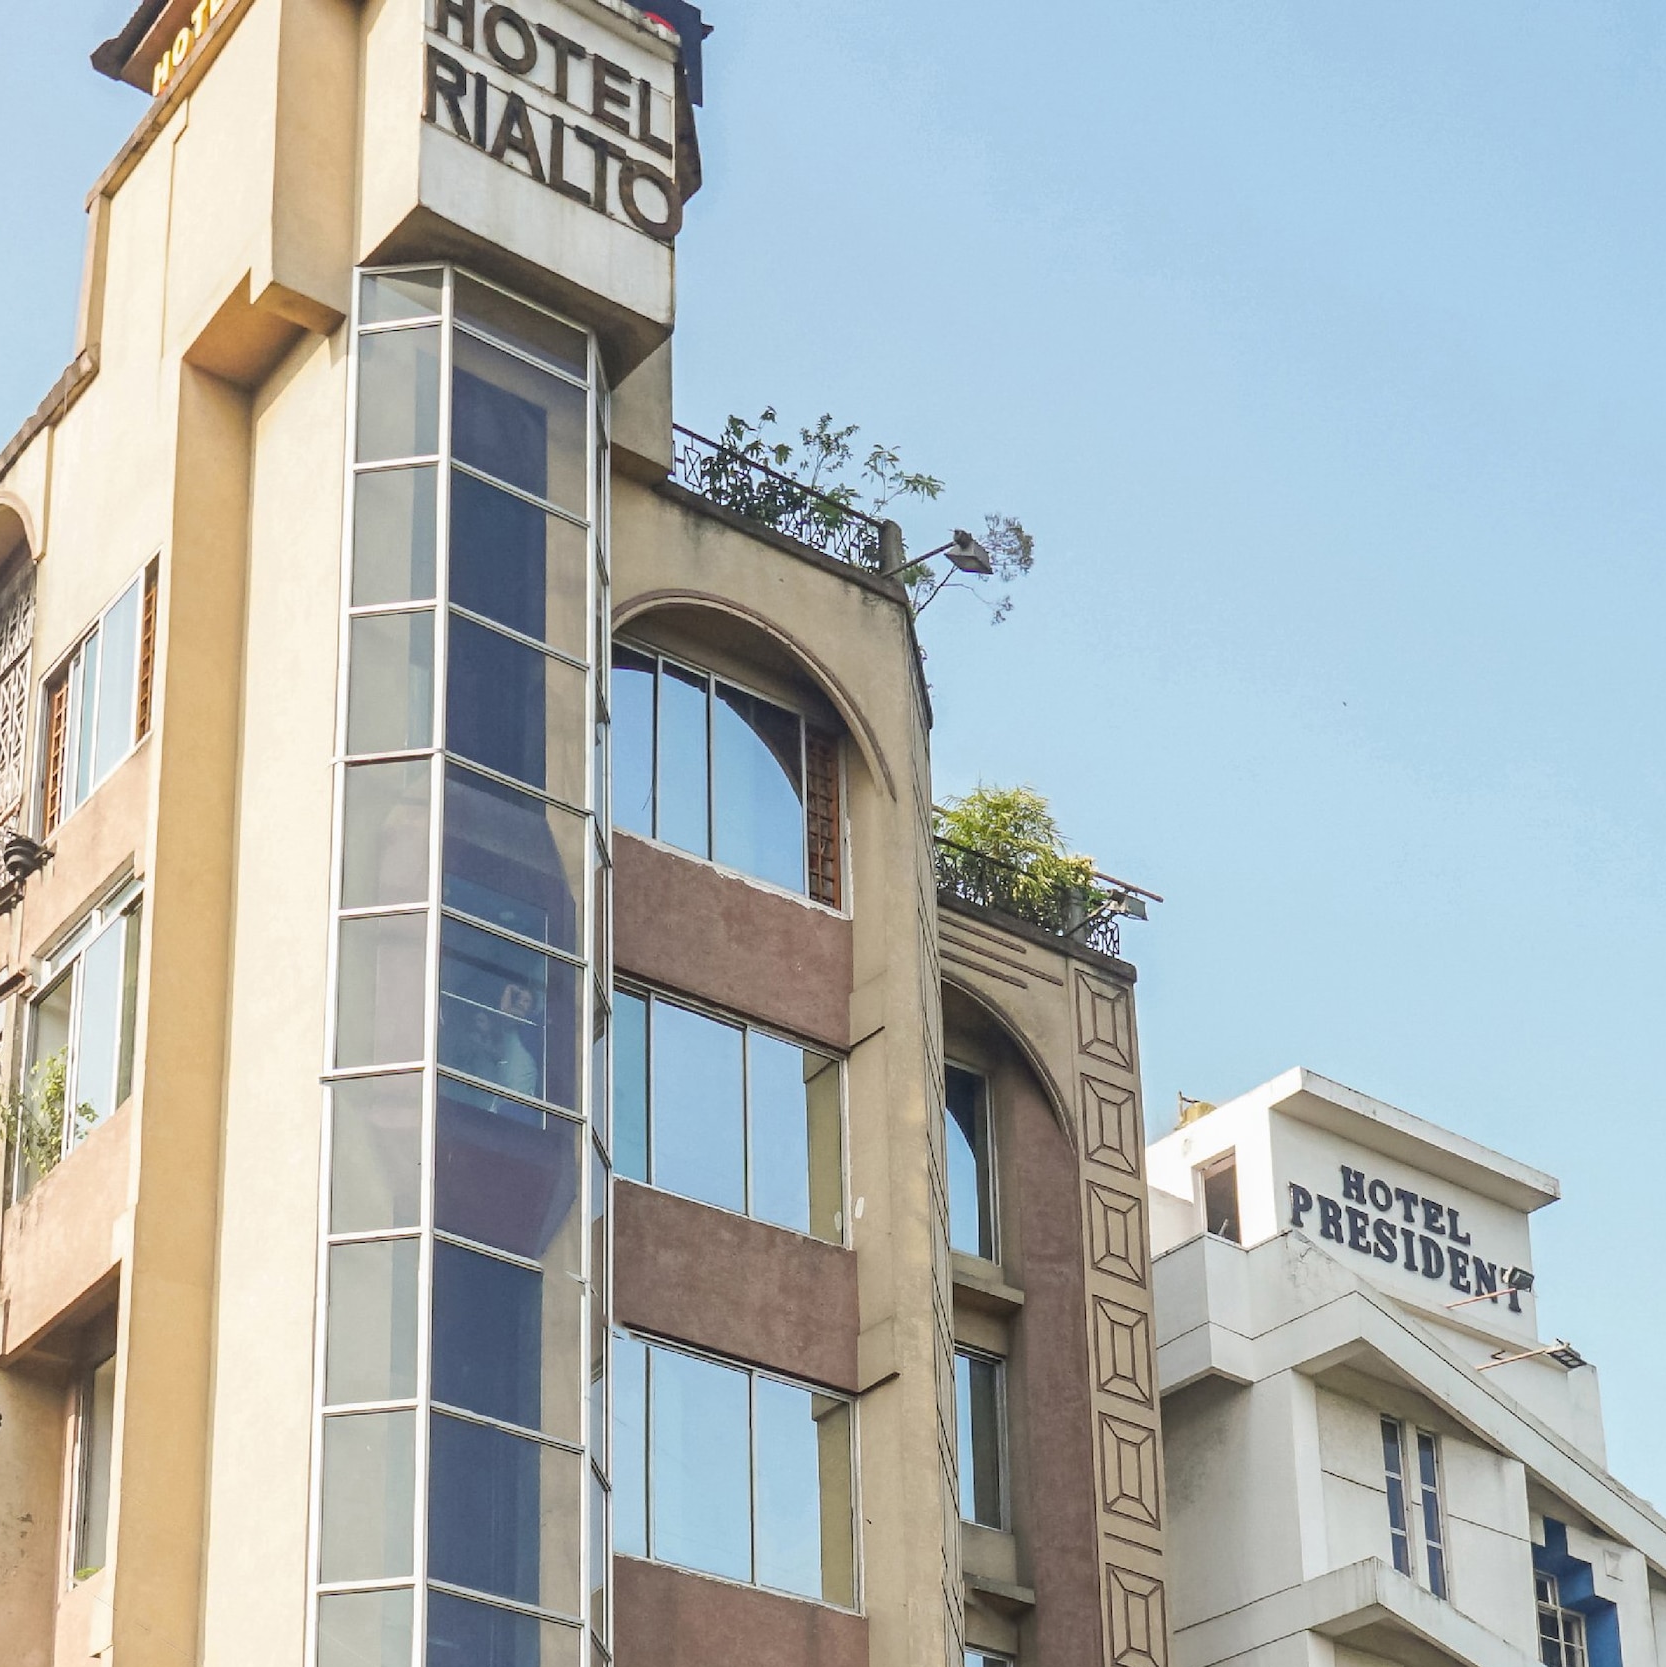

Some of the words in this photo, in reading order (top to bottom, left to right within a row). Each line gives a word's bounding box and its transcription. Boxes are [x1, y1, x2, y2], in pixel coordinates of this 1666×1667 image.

[422, 44, 683, 239] RIALTO
[434, 0, 674, 160] HOTEL
[1341, 1164, 1471, 1246] HOTEL
